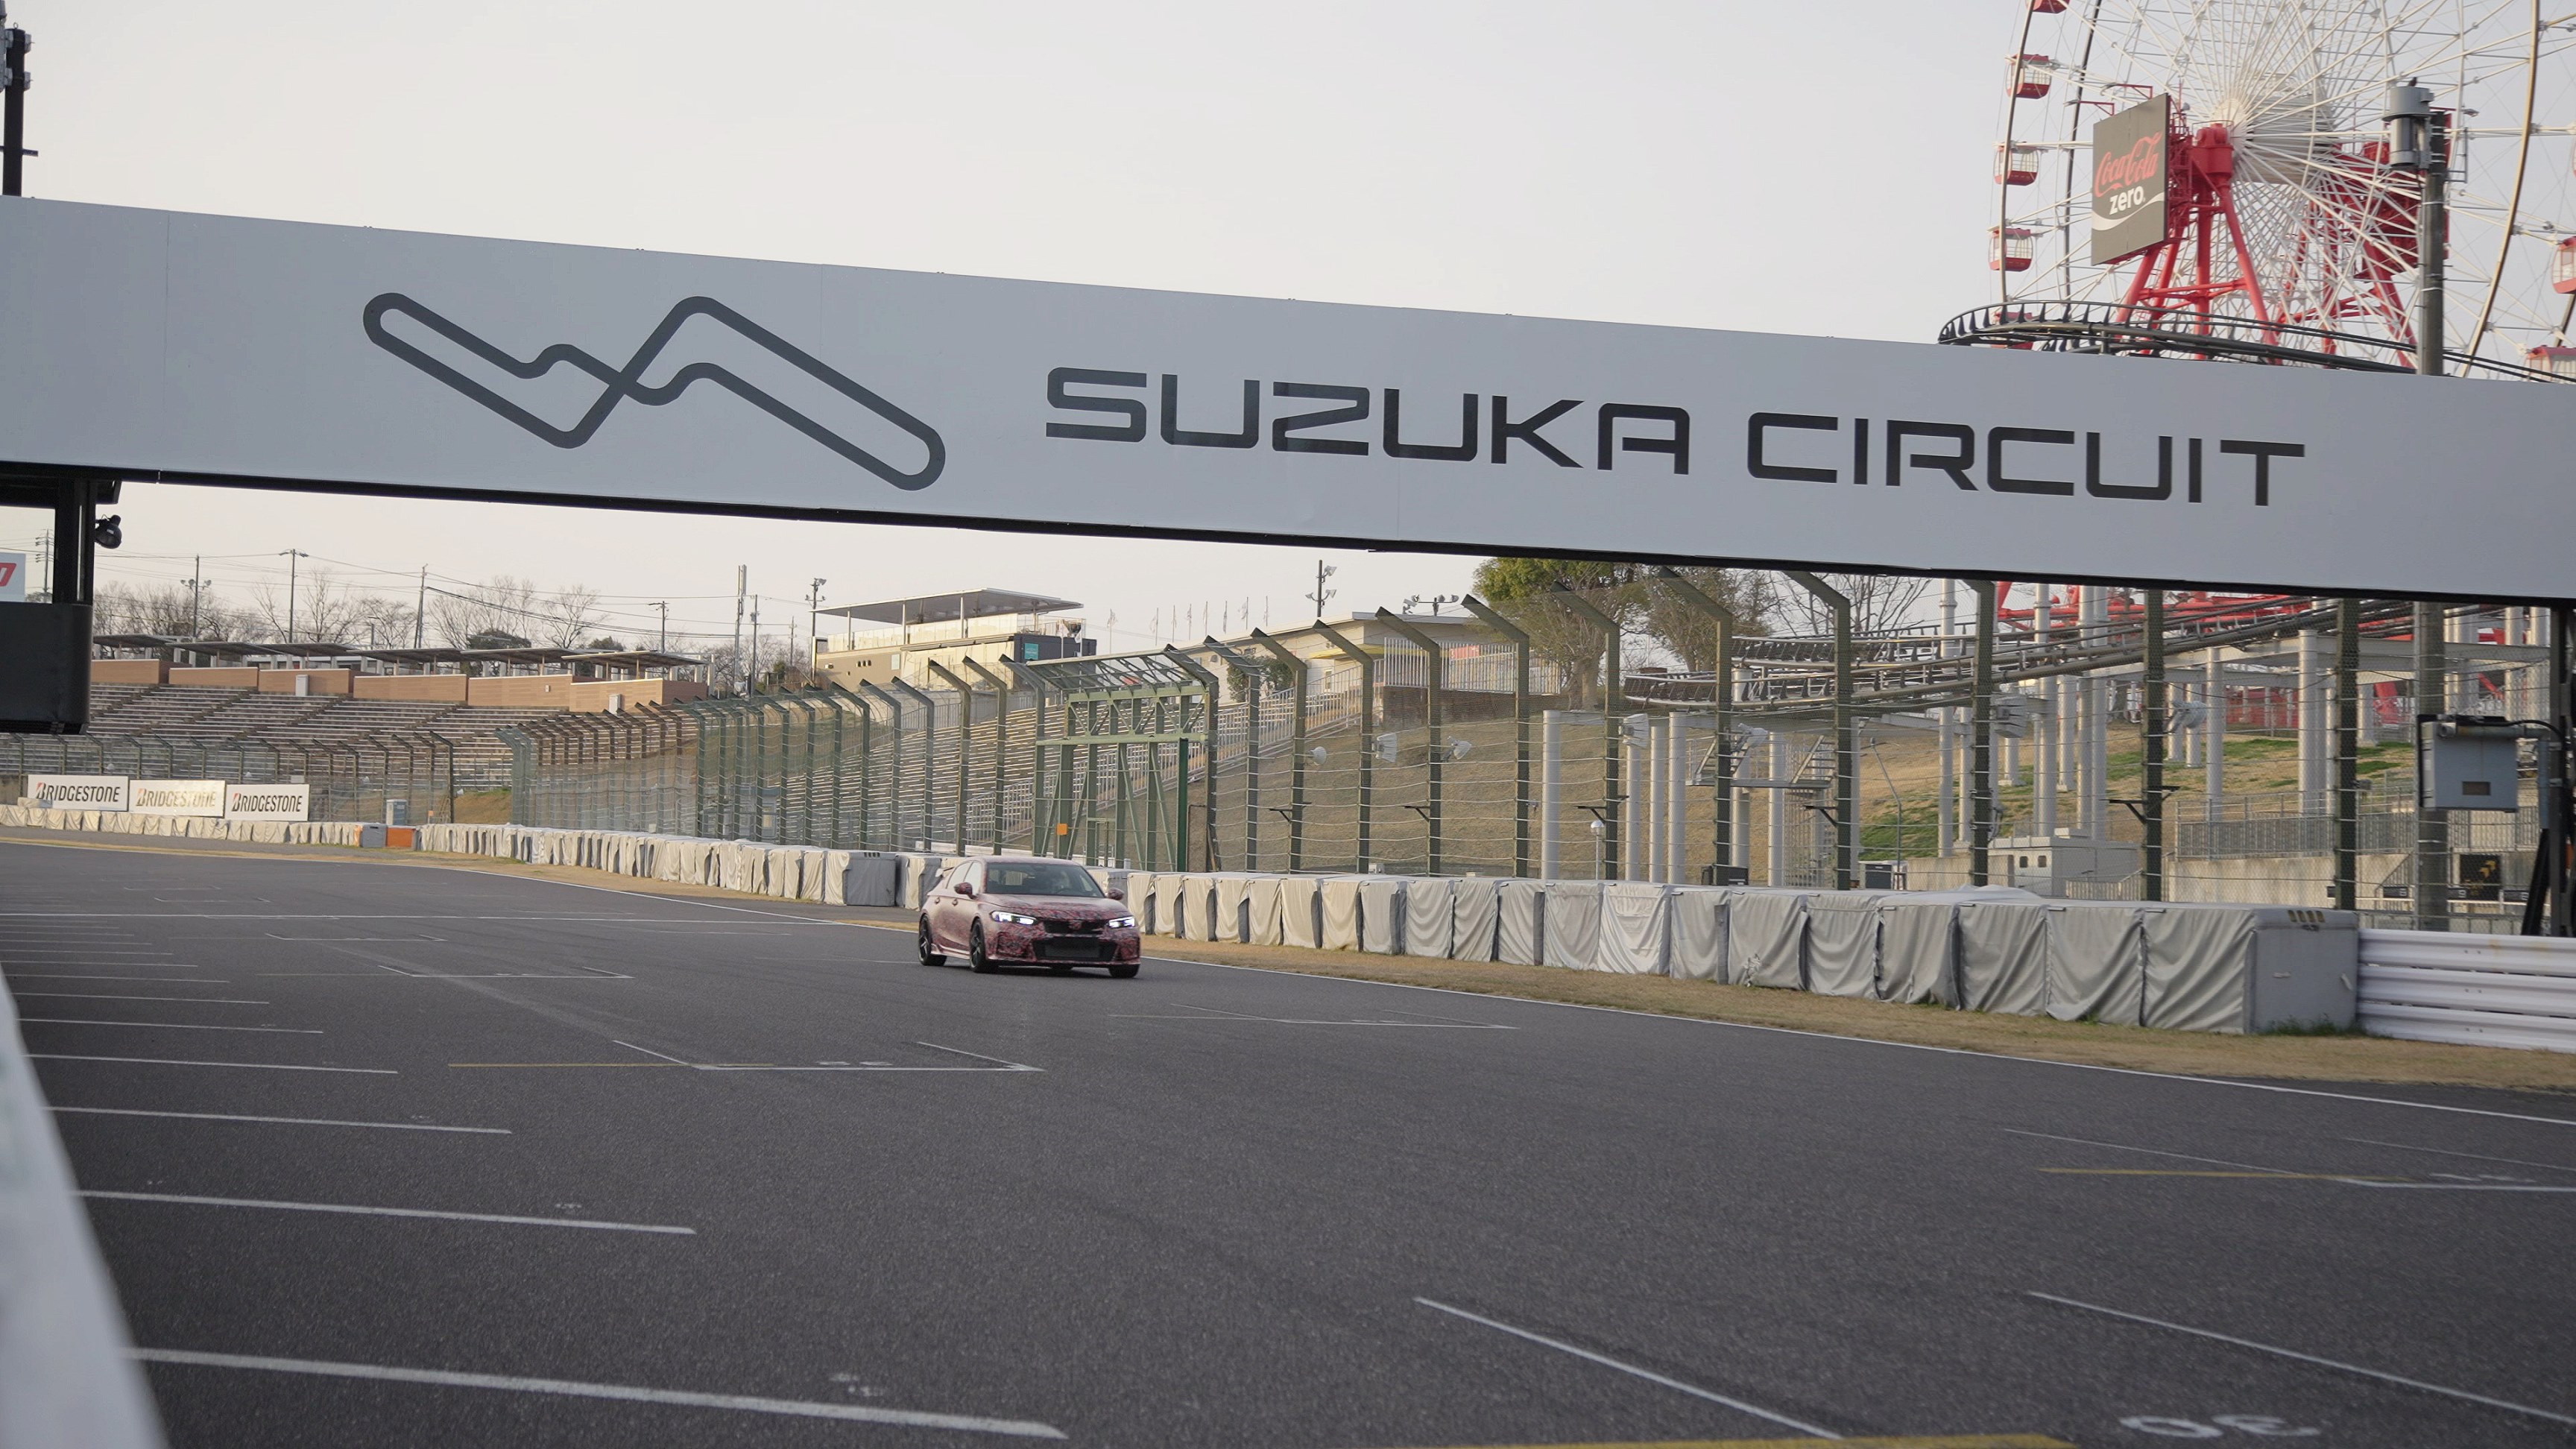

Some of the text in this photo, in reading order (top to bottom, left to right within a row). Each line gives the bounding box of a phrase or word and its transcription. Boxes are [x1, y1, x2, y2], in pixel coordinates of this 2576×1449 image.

[2109, 186, 2144, 215] zero
[1046, 367, 2305, 506] SUZUKA CIRCUIT
[36, 782, 120, 803] BRIDGESTONE
[136, 788, 215, 807] BRIDGESTONE
[232, 792, 302, 812] BRIDGESTONE
